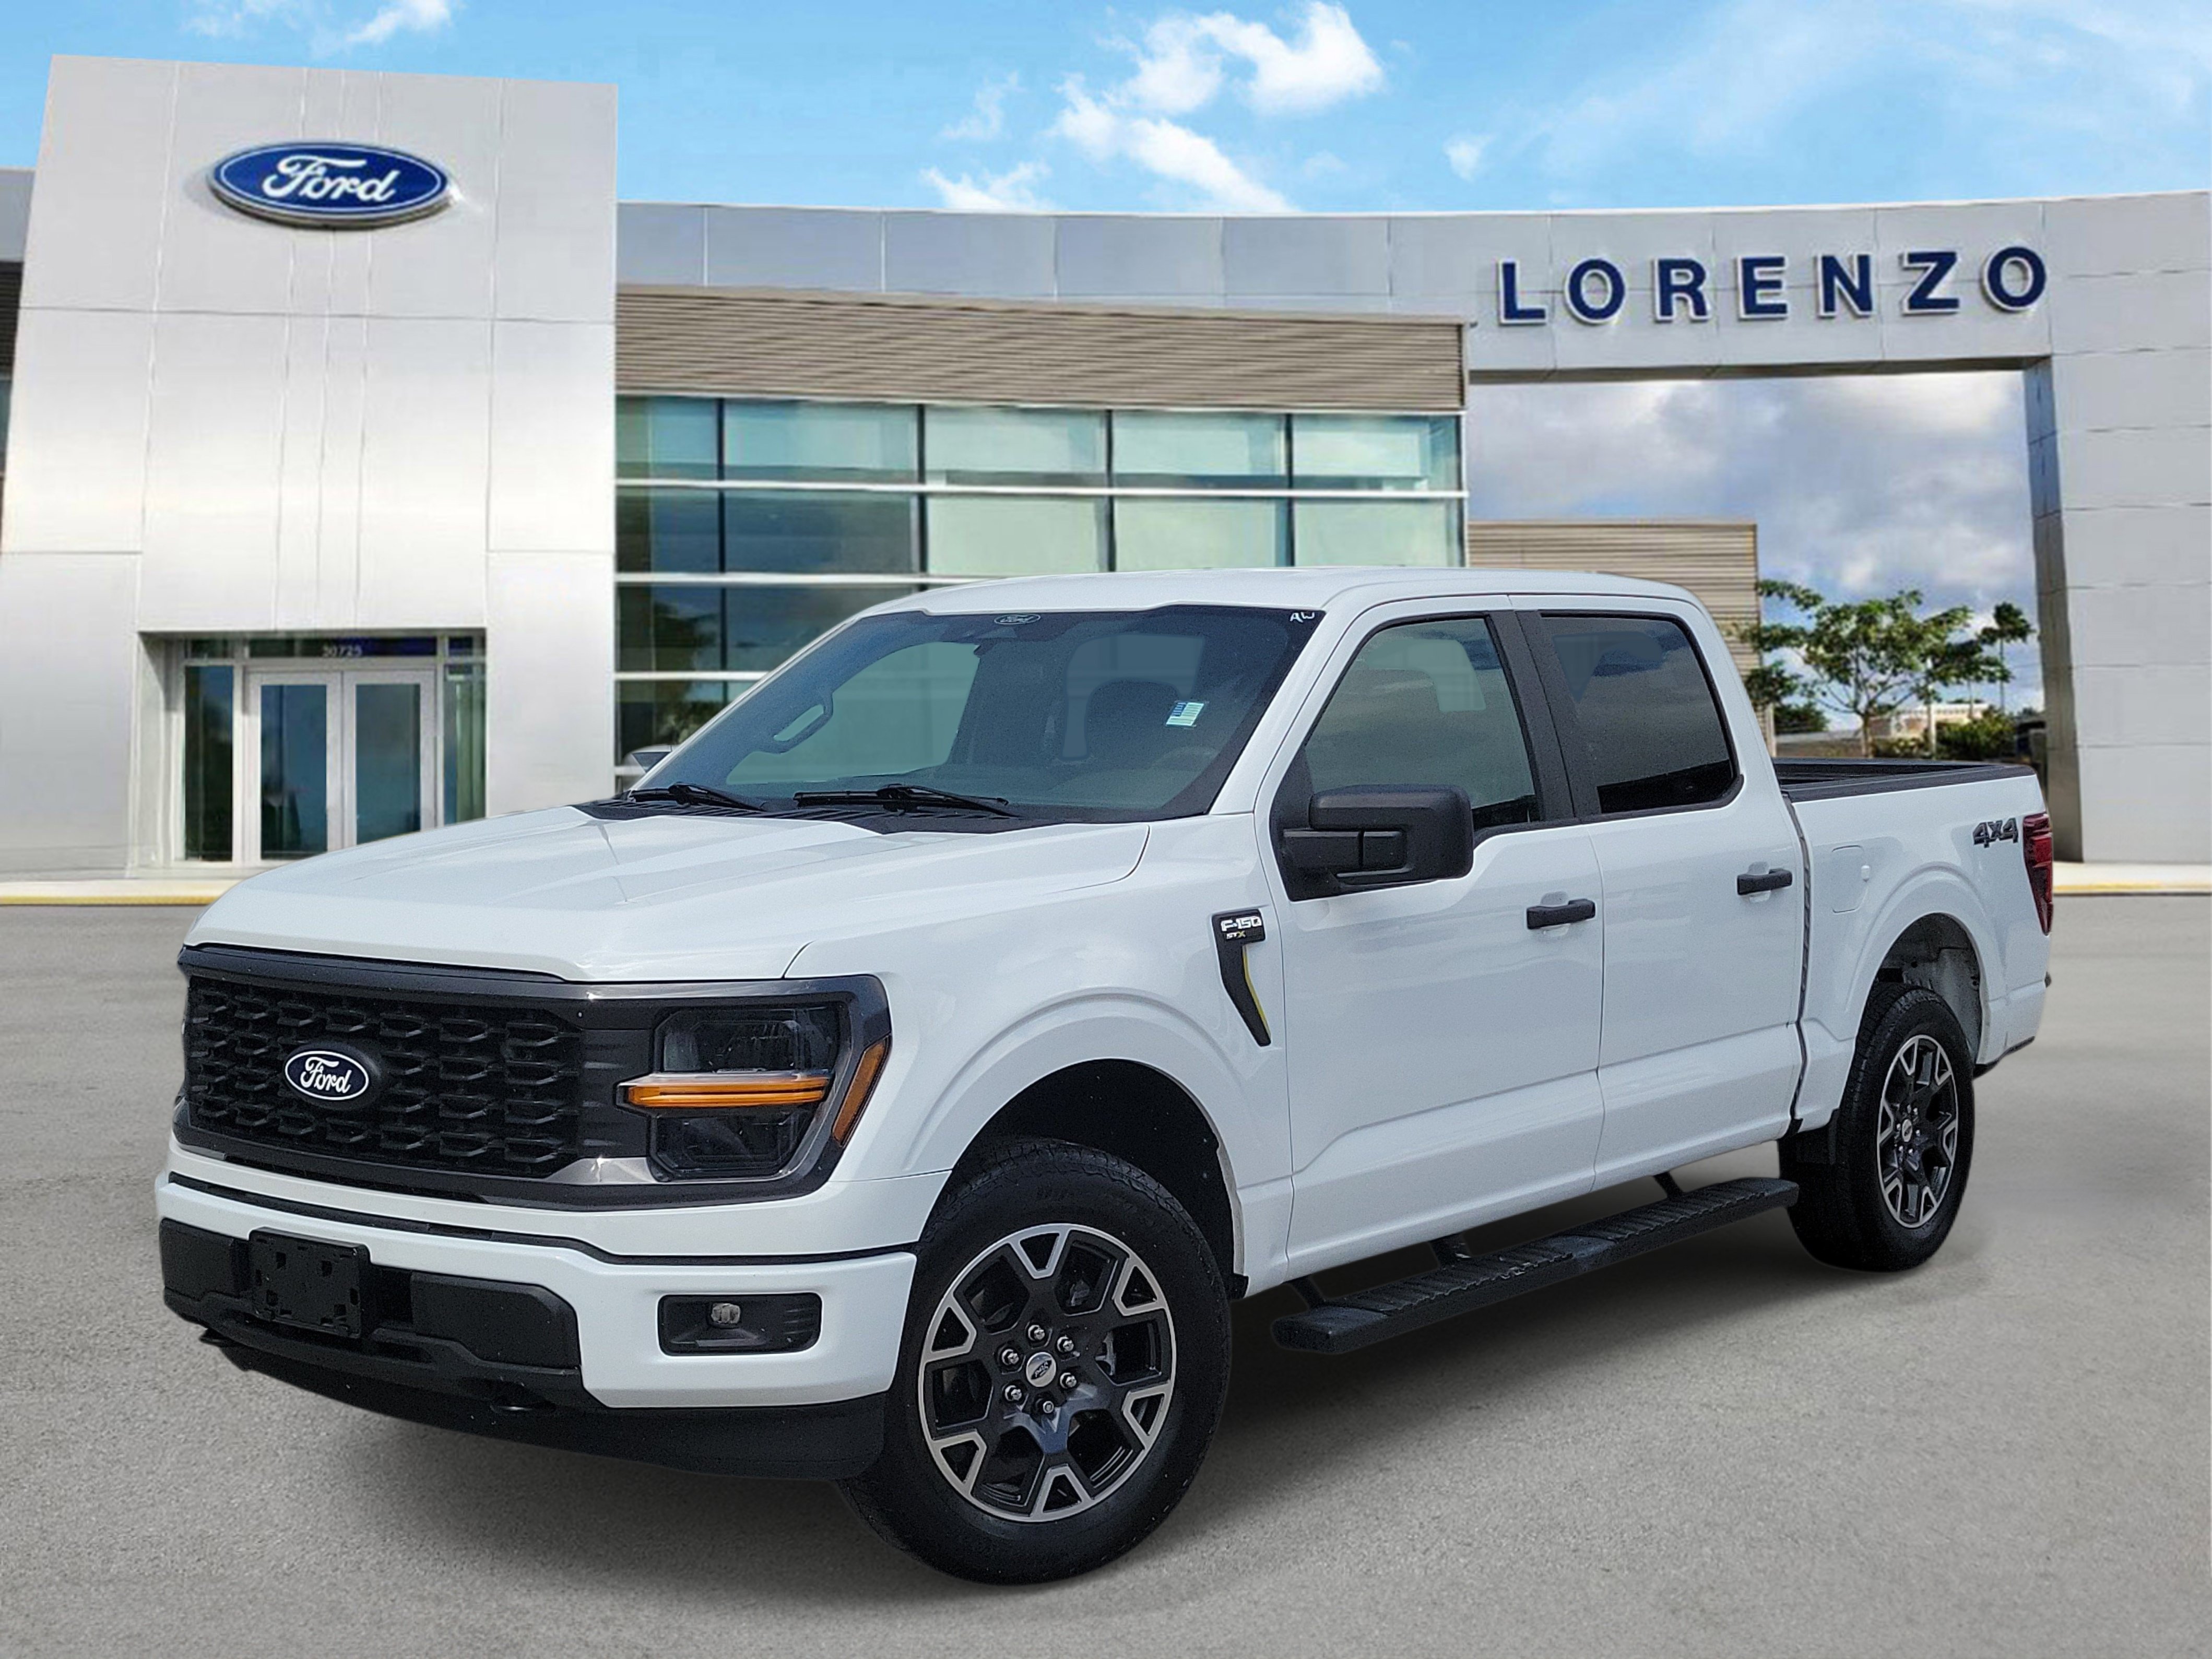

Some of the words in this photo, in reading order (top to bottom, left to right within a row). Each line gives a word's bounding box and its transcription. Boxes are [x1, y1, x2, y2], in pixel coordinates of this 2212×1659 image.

[261, 154, 400, 202] Ford
[1497, 246, 2048, 325] LORENZO
[1221, 916, 1262, 931] F-150
[1226, 930, 1246, 939] STX
[300, 1057, 352, 1094] Ford
